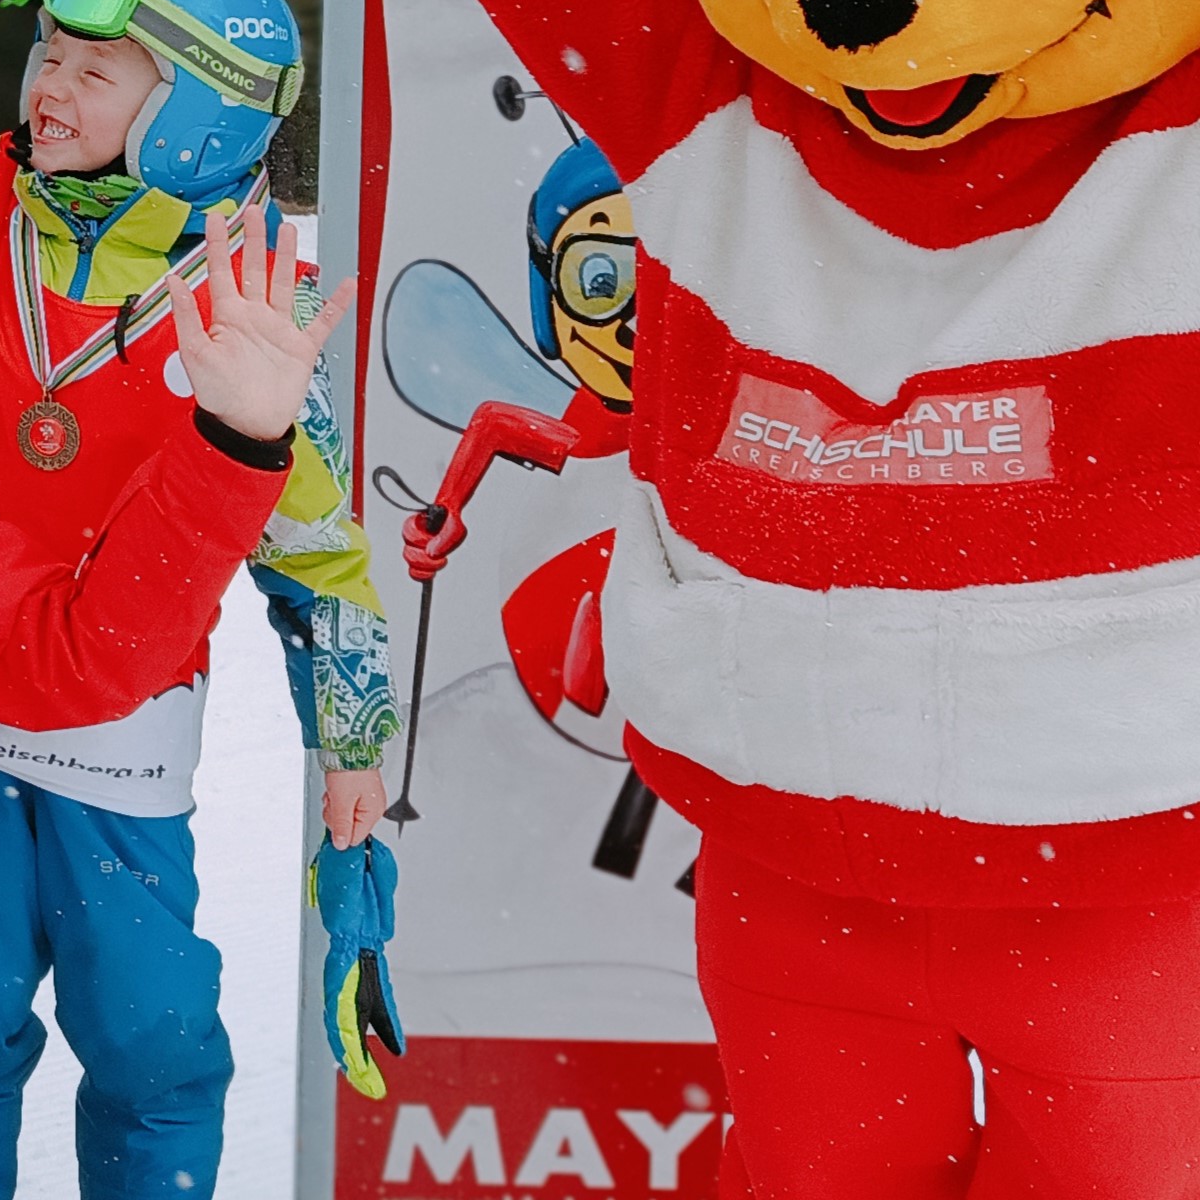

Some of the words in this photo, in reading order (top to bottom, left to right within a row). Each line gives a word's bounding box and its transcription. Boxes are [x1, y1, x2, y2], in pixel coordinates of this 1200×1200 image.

[184, 44, 257, 92] ATOMIC
[734, 412, 1022, 465] SCHISCHULE
[383, 1104, 734, 1190] MAY
